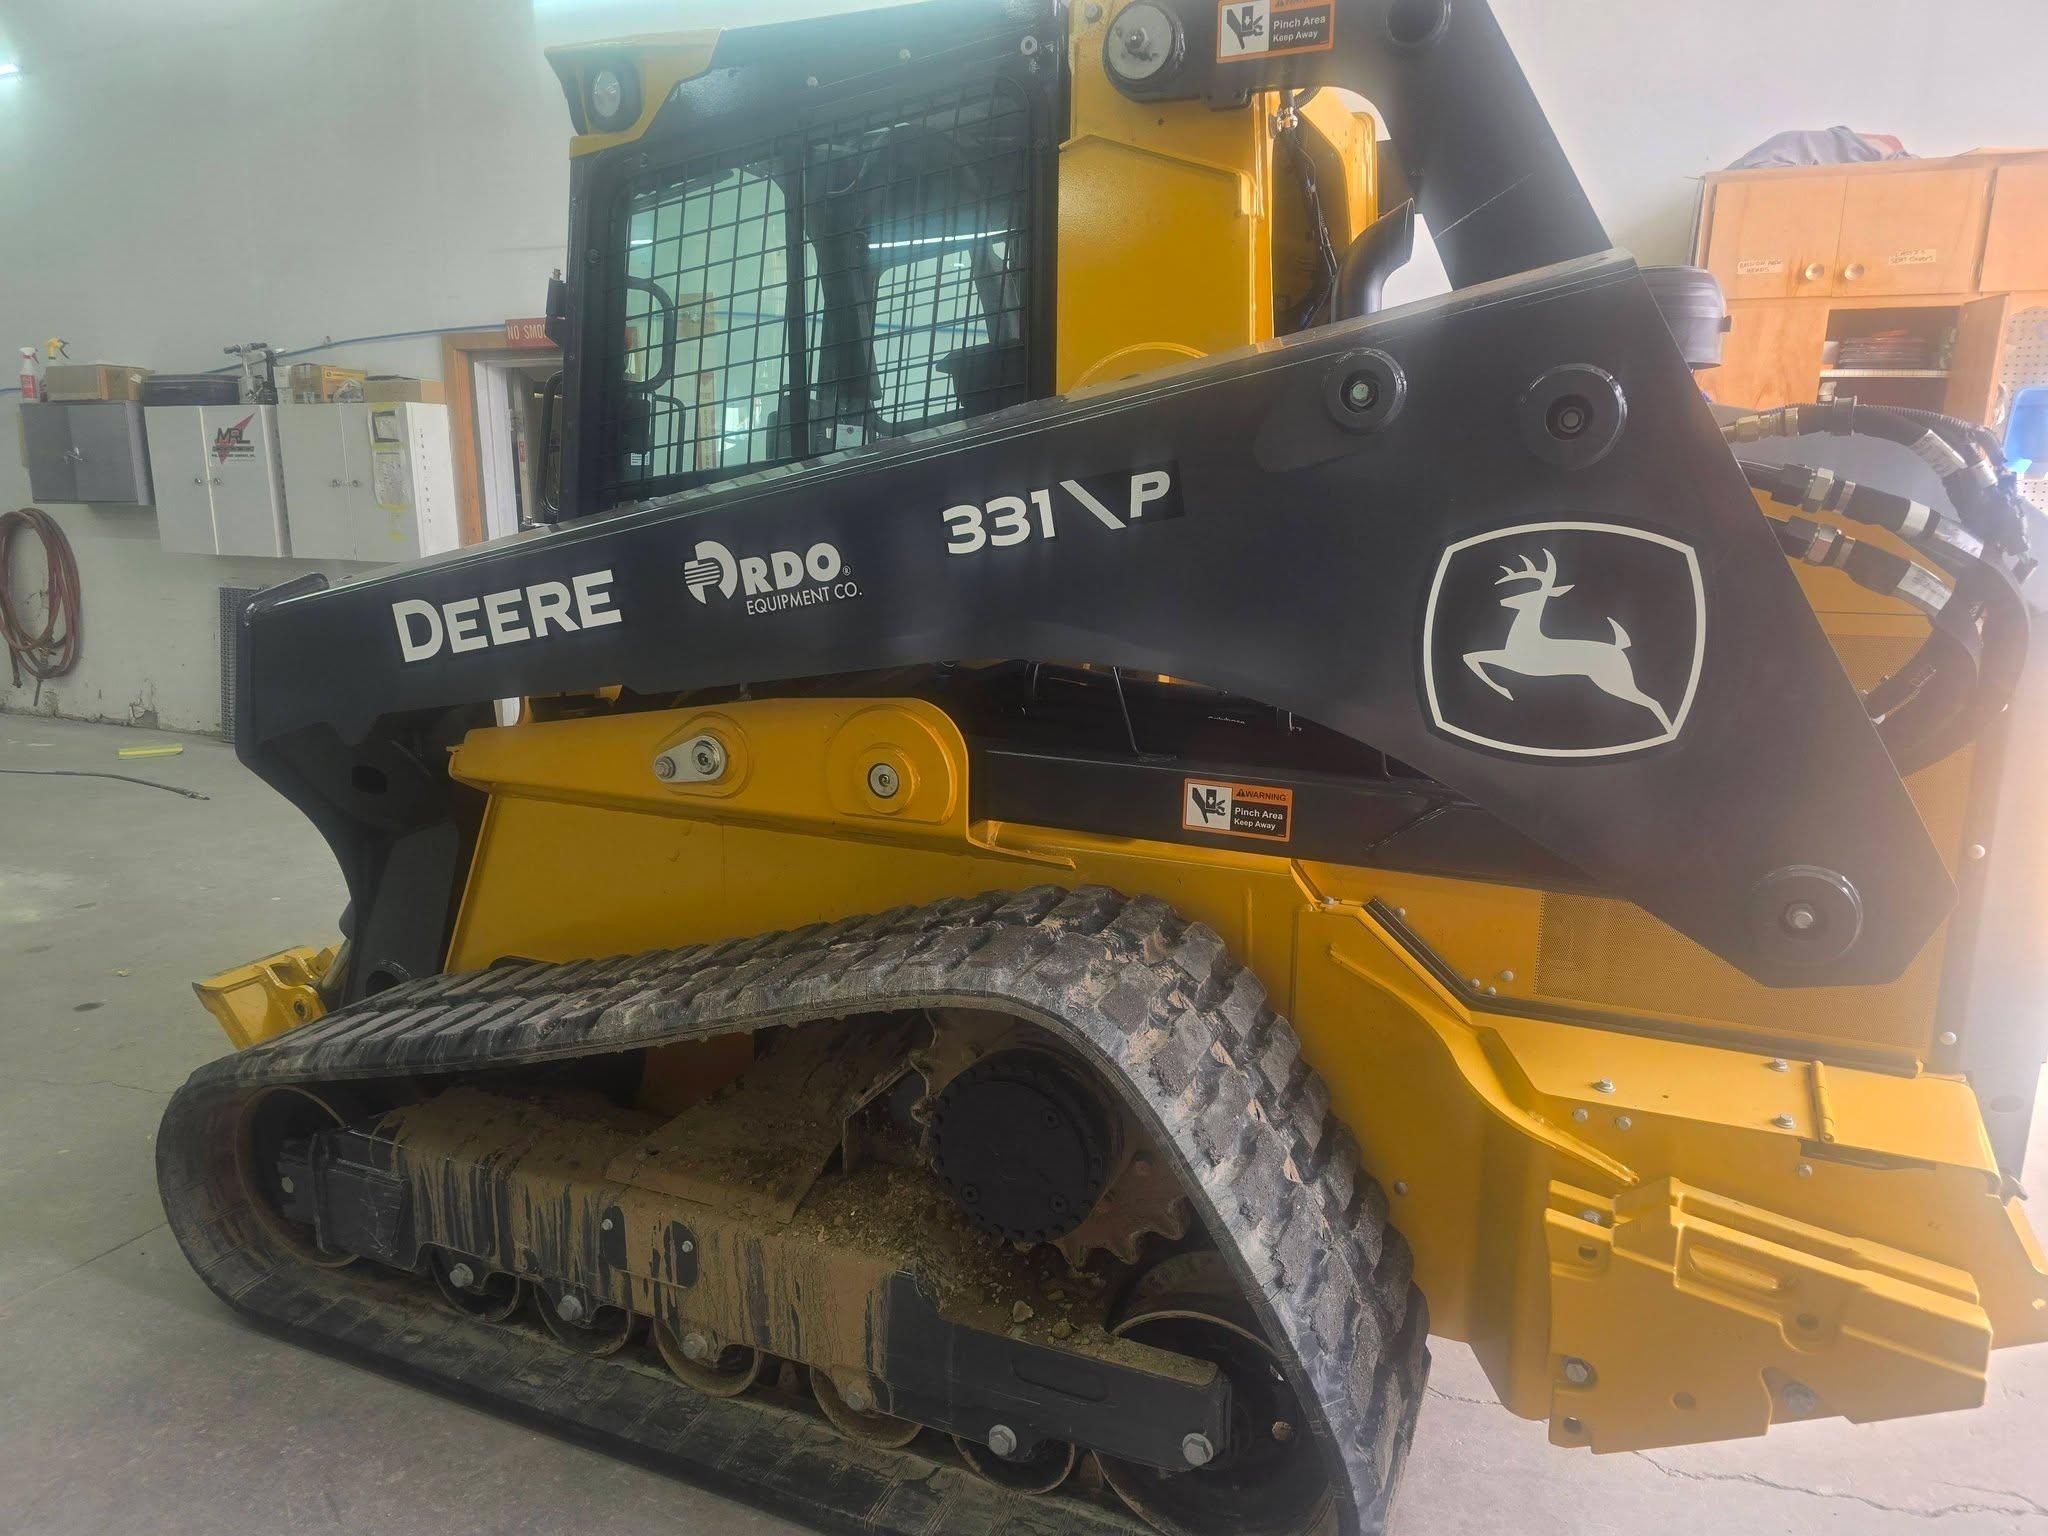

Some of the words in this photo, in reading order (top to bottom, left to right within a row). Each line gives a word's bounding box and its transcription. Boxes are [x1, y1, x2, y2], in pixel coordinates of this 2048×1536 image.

[1273, 18, 1301, 30] Pinch
[1303, 15, 1326, 26] Area
[1273, 33, 1294, 43] Keep
[1295, 30, 1319, 41] Away
[507, 325, 520, 340] NO
[943, 488, 1056, 554] 331
[746, 586, 830, 616] EQUIPMENT
[834, 581, 863, 600] CO.
[391, 569, 623, 663] DEERE
[1245, 790, 1287, 802] WARNING
[1234, 806, 1260, 818] Pinch
[1261, 808, 1284, 820] Area
[1233, 818, 1254, 828] Keep
[1254, 820, 1276, 831] Away
